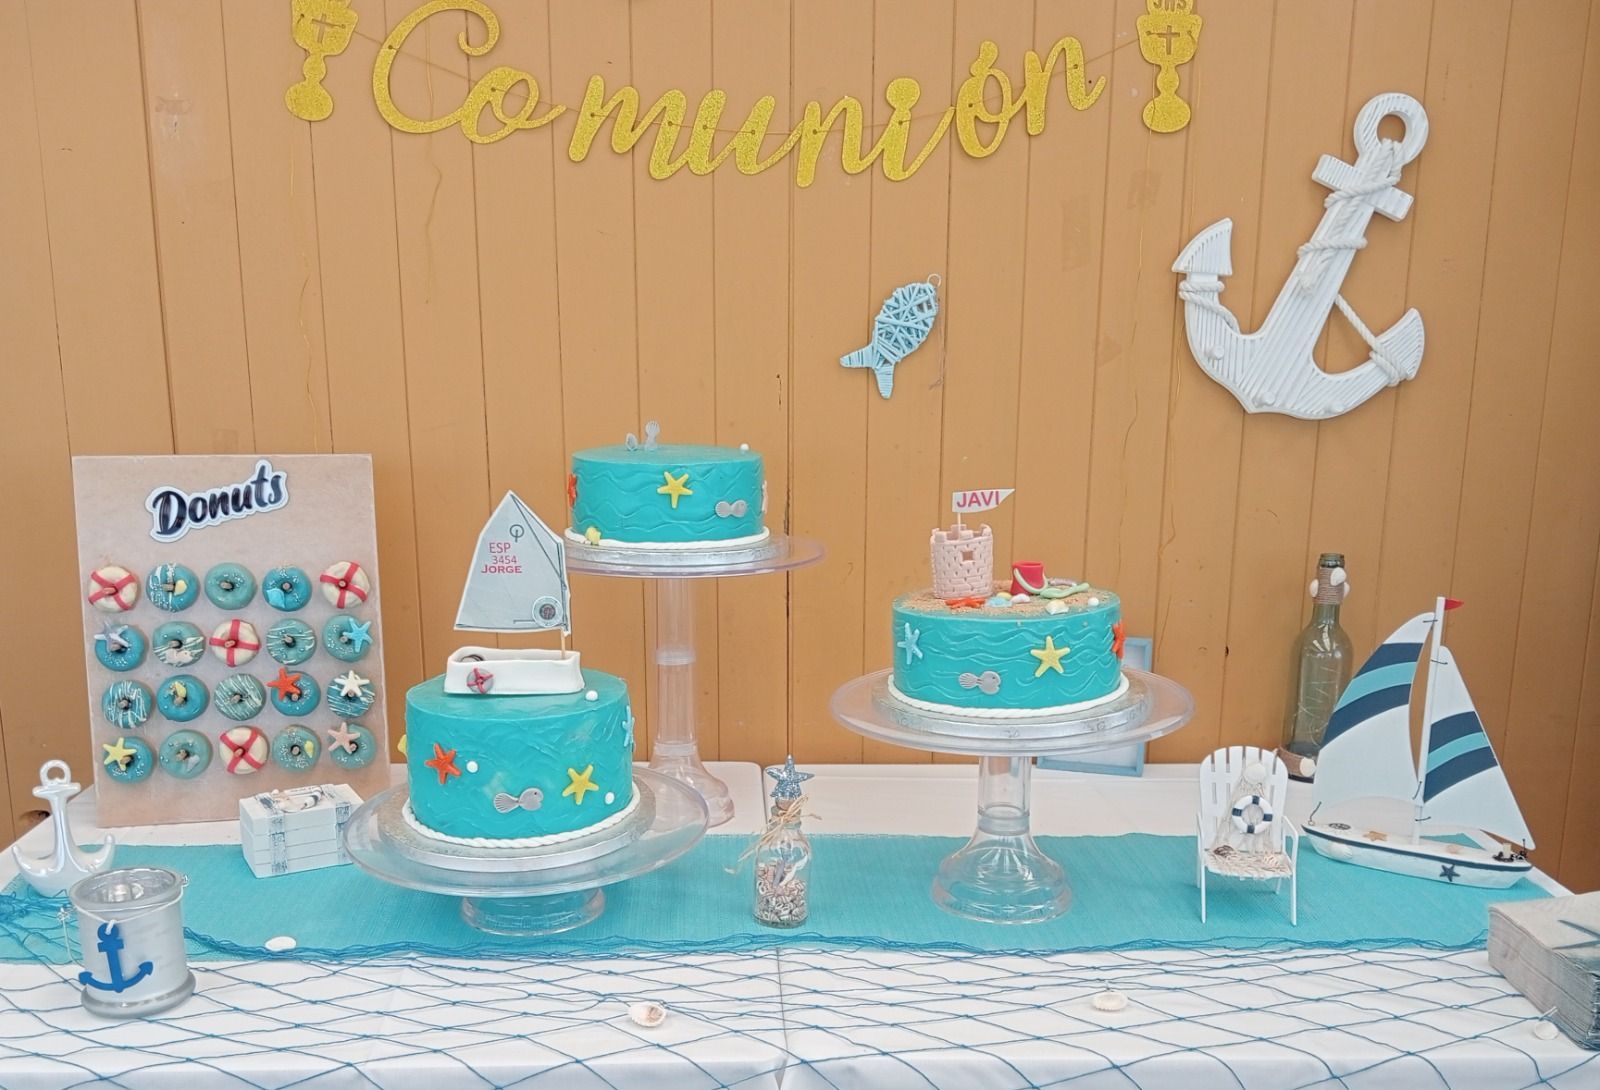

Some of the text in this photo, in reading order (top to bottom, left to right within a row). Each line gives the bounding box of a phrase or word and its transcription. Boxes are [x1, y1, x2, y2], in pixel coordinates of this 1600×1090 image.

[372, 0, 1107, 188] Comunión
[152, 464, 284, 535] Donuts
[956, 490, 999, 508] JAVI
[488, 542, 512, 554] ESP
[492, 555, 518, 565] 3454
[481, 565, 523, 574] JORGE
